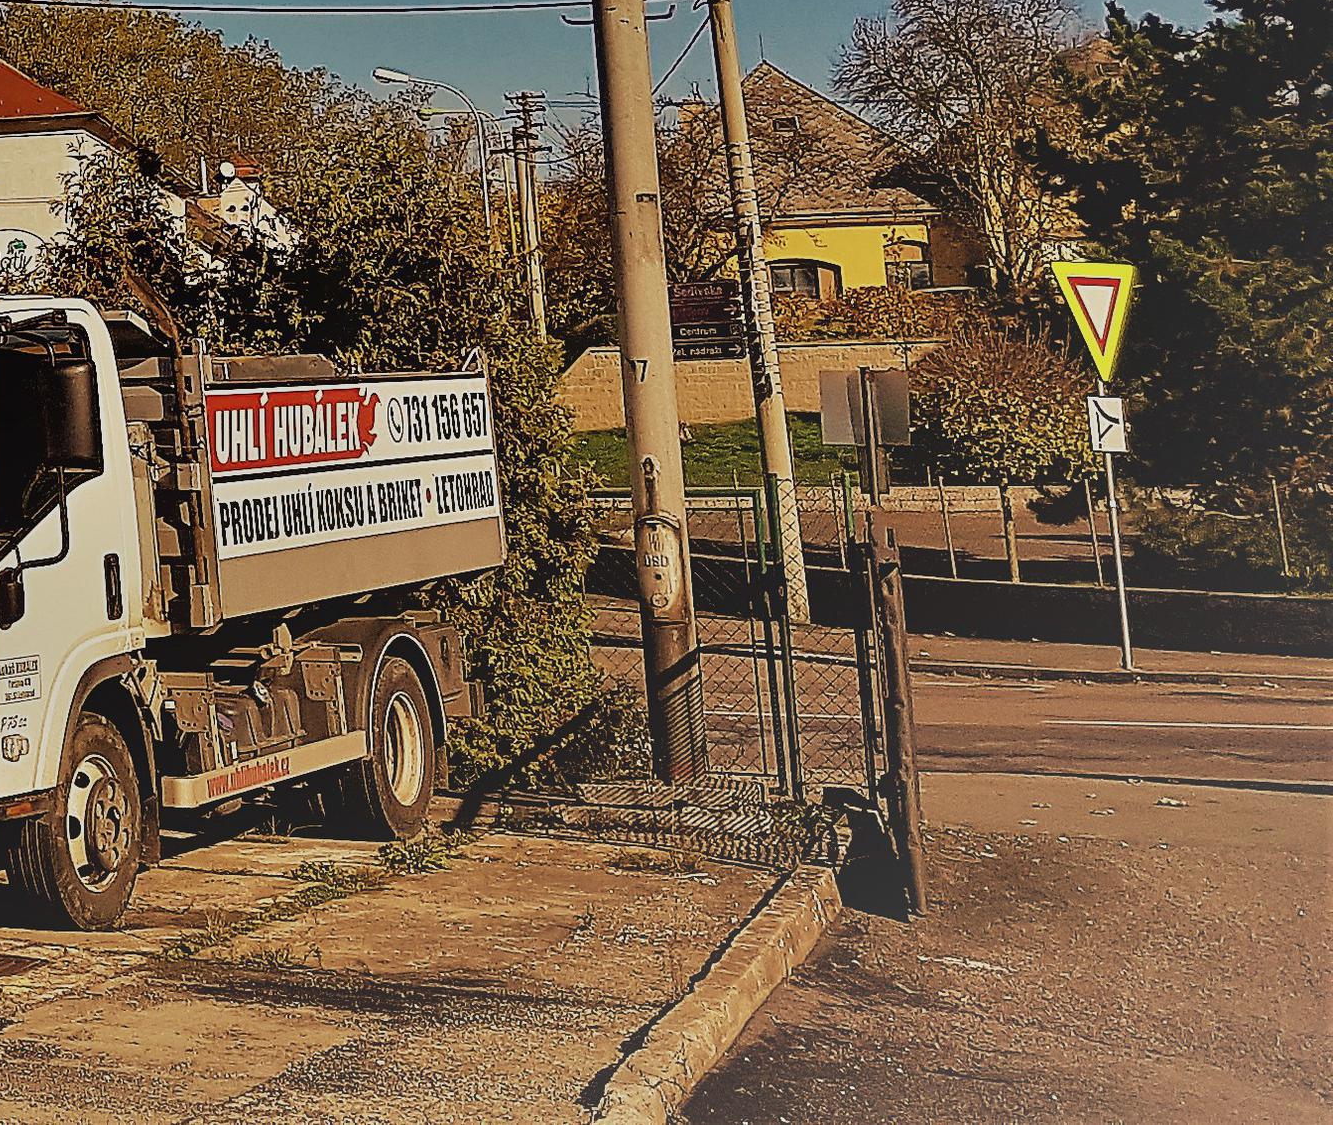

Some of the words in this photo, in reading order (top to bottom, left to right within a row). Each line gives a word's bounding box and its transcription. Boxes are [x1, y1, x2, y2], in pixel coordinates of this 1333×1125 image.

[214, 391, 268, 464] UHLÍ
[273, 390, 360, 458] HUBÁLEK
[403, 395, 431, 443] 731
[431, 393, 459, 440] 156
[463, 392, 488, 438] 657
[219, 496, 280, 546] PRODEJ
[281, 483, 315, 538] UHLÍ
[316, 485, 366, 532] KOKSU
[366, 484, 378, 525] A
[378, 478, 424, 524] BRIKET
[435, 470, 495, 515] LETOHRAD
